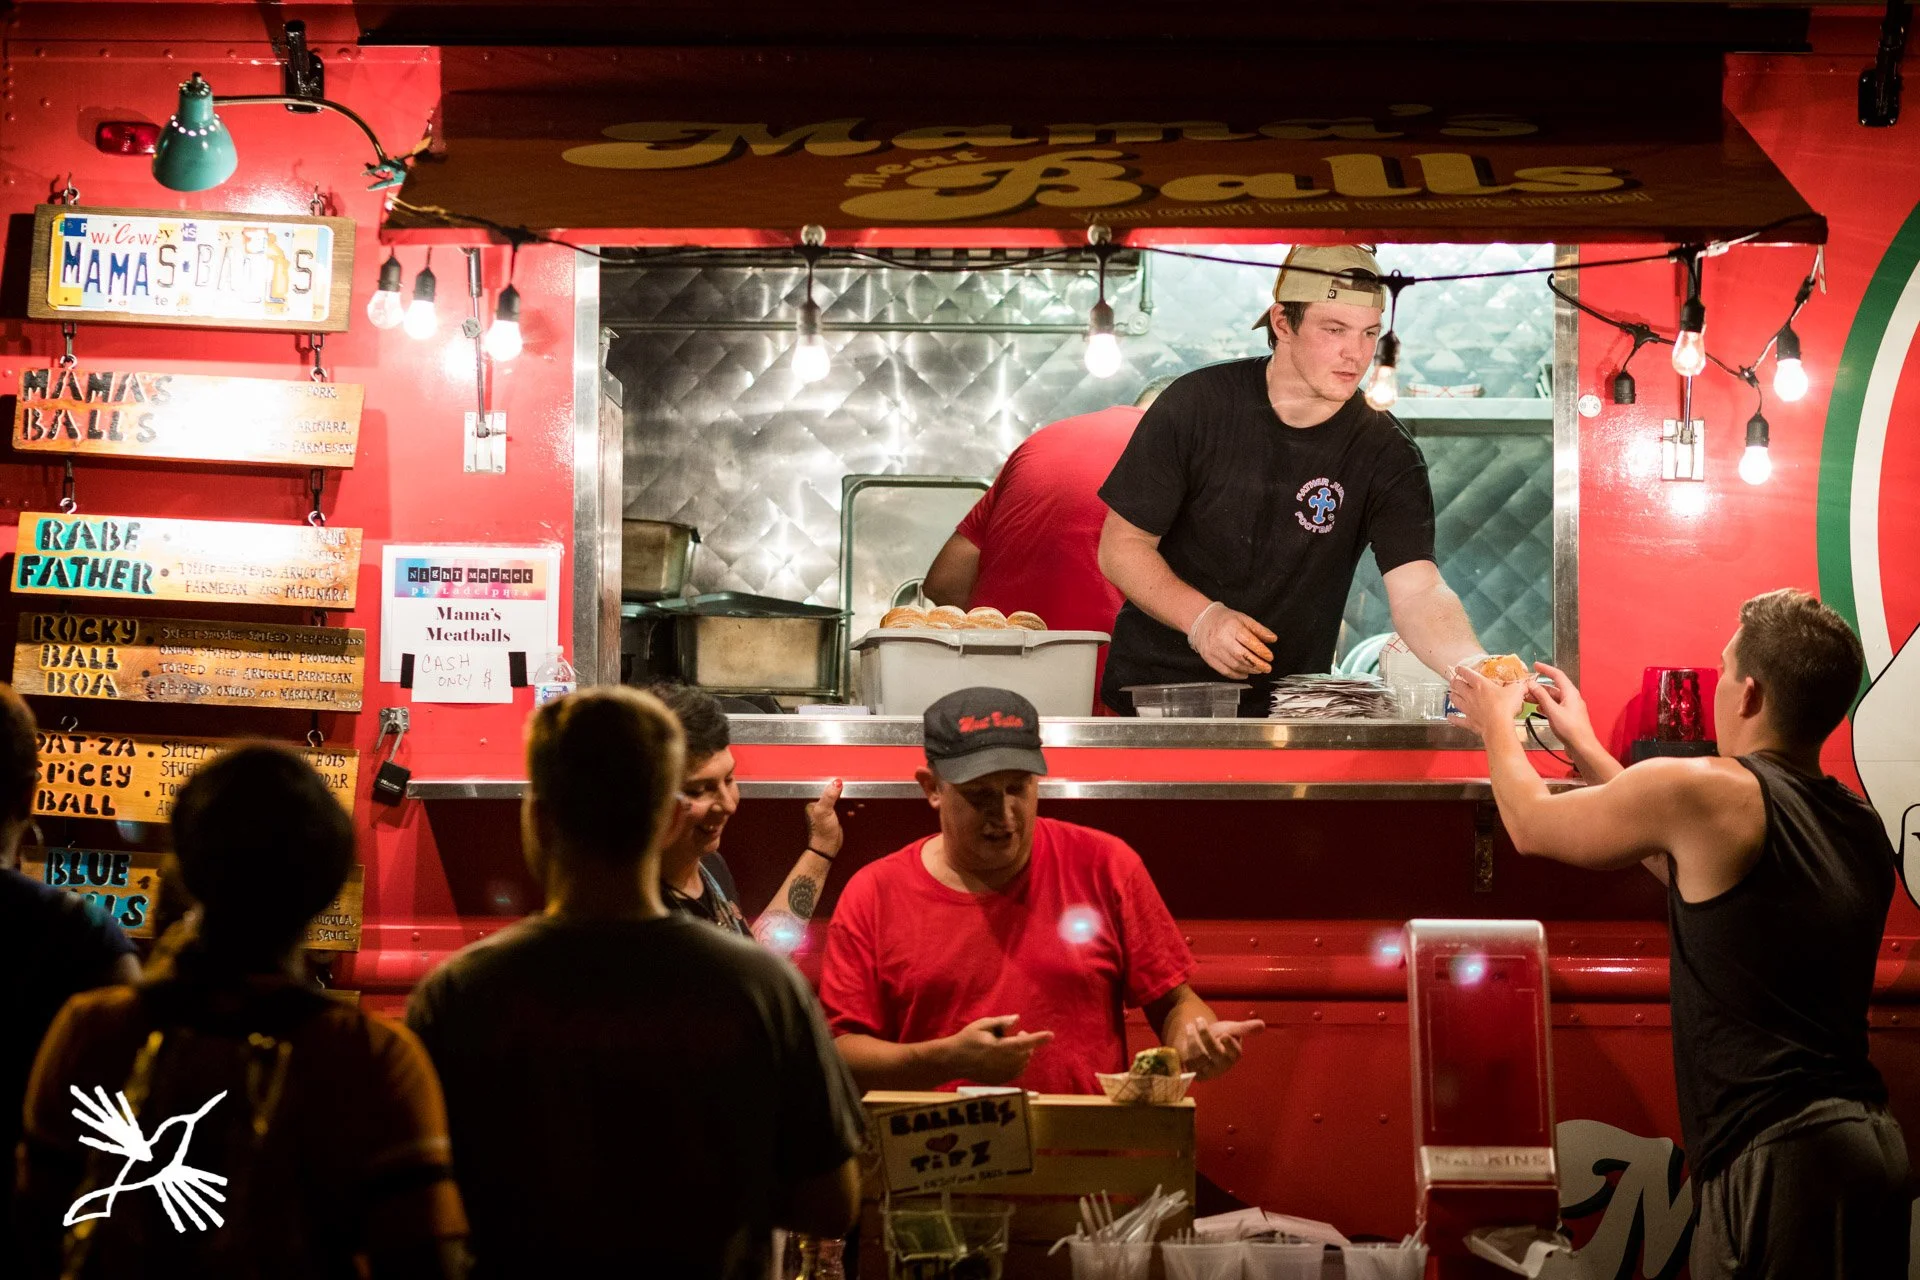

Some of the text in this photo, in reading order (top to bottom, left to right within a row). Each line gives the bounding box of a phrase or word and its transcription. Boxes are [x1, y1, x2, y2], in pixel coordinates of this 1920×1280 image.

[561, 103, 1539, 170] Mama's
[840, 149, 1624, 221] Balls
[22, 408, 158, 443] BALLS
[41, 519, 140, 551] RABE
[19, 555, 154, 594] FATHER
[437, 606, 502, 621] Mama's
[33, 614, 139, 645] ROCKY
[425, 627, 511, 643] Meatballs
[40, 644, 121, 671] BALL
[421, 653, 471, 673] CASH
[46, 671, 120, 699] BOA
[36, 761, 132, 789] PiCEY
[37, 789, 117, 816] BALL
[46, 851, 130, 887] BLUE
